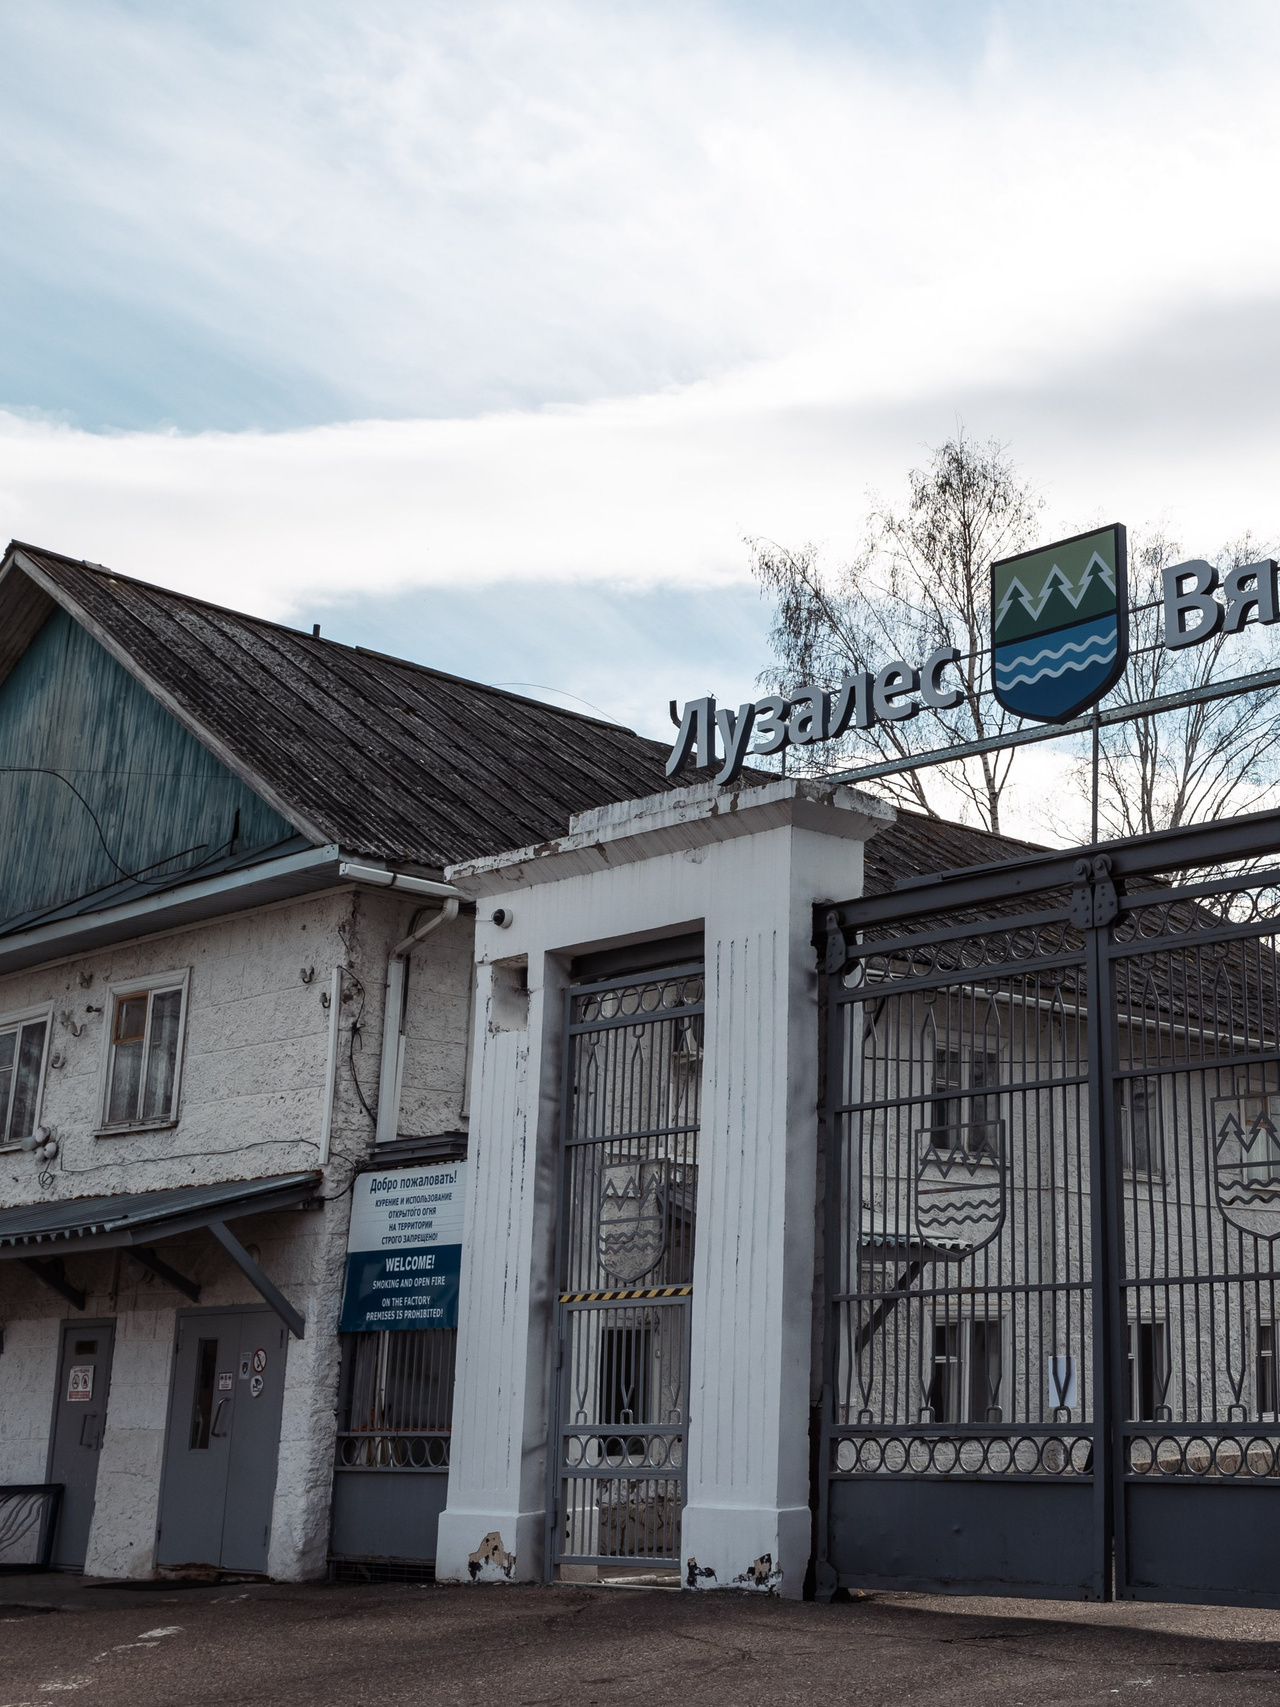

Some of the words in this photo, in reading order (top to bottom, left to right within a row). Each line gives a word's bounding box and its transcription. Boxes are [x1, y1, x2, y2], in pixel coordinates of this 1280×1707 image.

[665, 647, 964, 786] Лузалес
[370, 1177, 397, 1194] Добро
[400, 1170, 457, 1189] пожаловать!
[375, 1198, 399, 1207] КУРЕНИЕ
[400, 1197, 405, 1206] И
[405, 1192, 452, 1204] ИСПОЛЬЗОВАНИЕ
[388, 1208, 421, 1219] ОТКРЫТОГО
[422, 1207, 436, 1216] ОГНЯ
[388, 1223, 396, 1231] НА
[398, 1221, 433, 1231] ТЕРРИТОРИИ
[381, 1235, 402, 1245] СТРОГО
[403, 1232, 438, 1243] ЗАПРЕЩЕНО!
[385, 1254, 435, 1272] WELCOME!
[372, 1279, 399, 1290] SMOKING
[400, 1278, 413, 1288] AND
[414, 1277, 430, 1287] OPEN
[431, 1276, 446, 1286] FIRE
[381, 1298, 390, 1307] ON
[392, 1297, 403, 1306] THE
[404, 1296, 431, 1306] FACTORY
[366, 1310, 395, 1321] PREMISES
[396, 1310, 403, 1320] IS
[404, 1308, 444, 1319] PROHIBITED!
